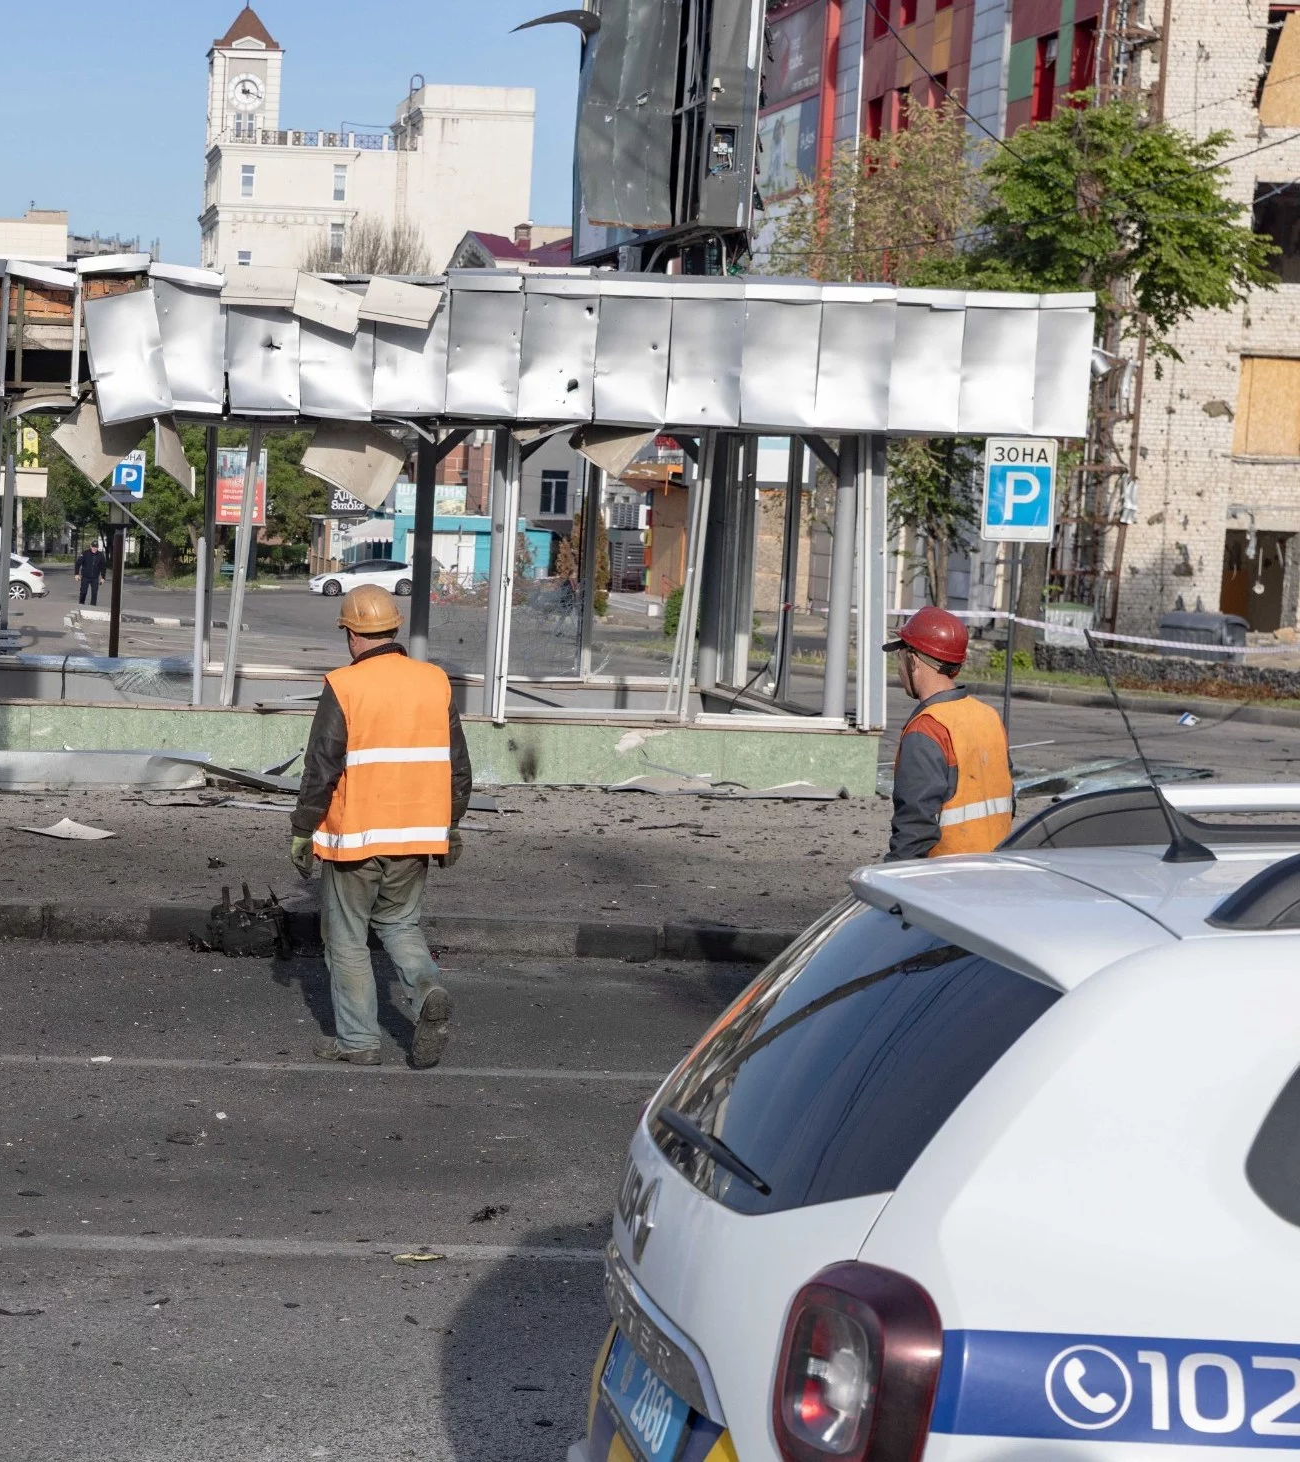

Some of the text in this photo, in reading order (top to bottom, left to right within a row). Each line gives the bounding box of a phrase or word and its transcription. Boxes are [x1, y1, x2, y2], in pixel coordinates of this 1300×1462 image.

[994, 446, 1049, 463] ЗОНА
[121, 467, 138, 484] P
[1004, 471, 1041, 520] P
[330, 500, 366, 511] Smoke
[1137, 1350, 1300, 1437] 102
